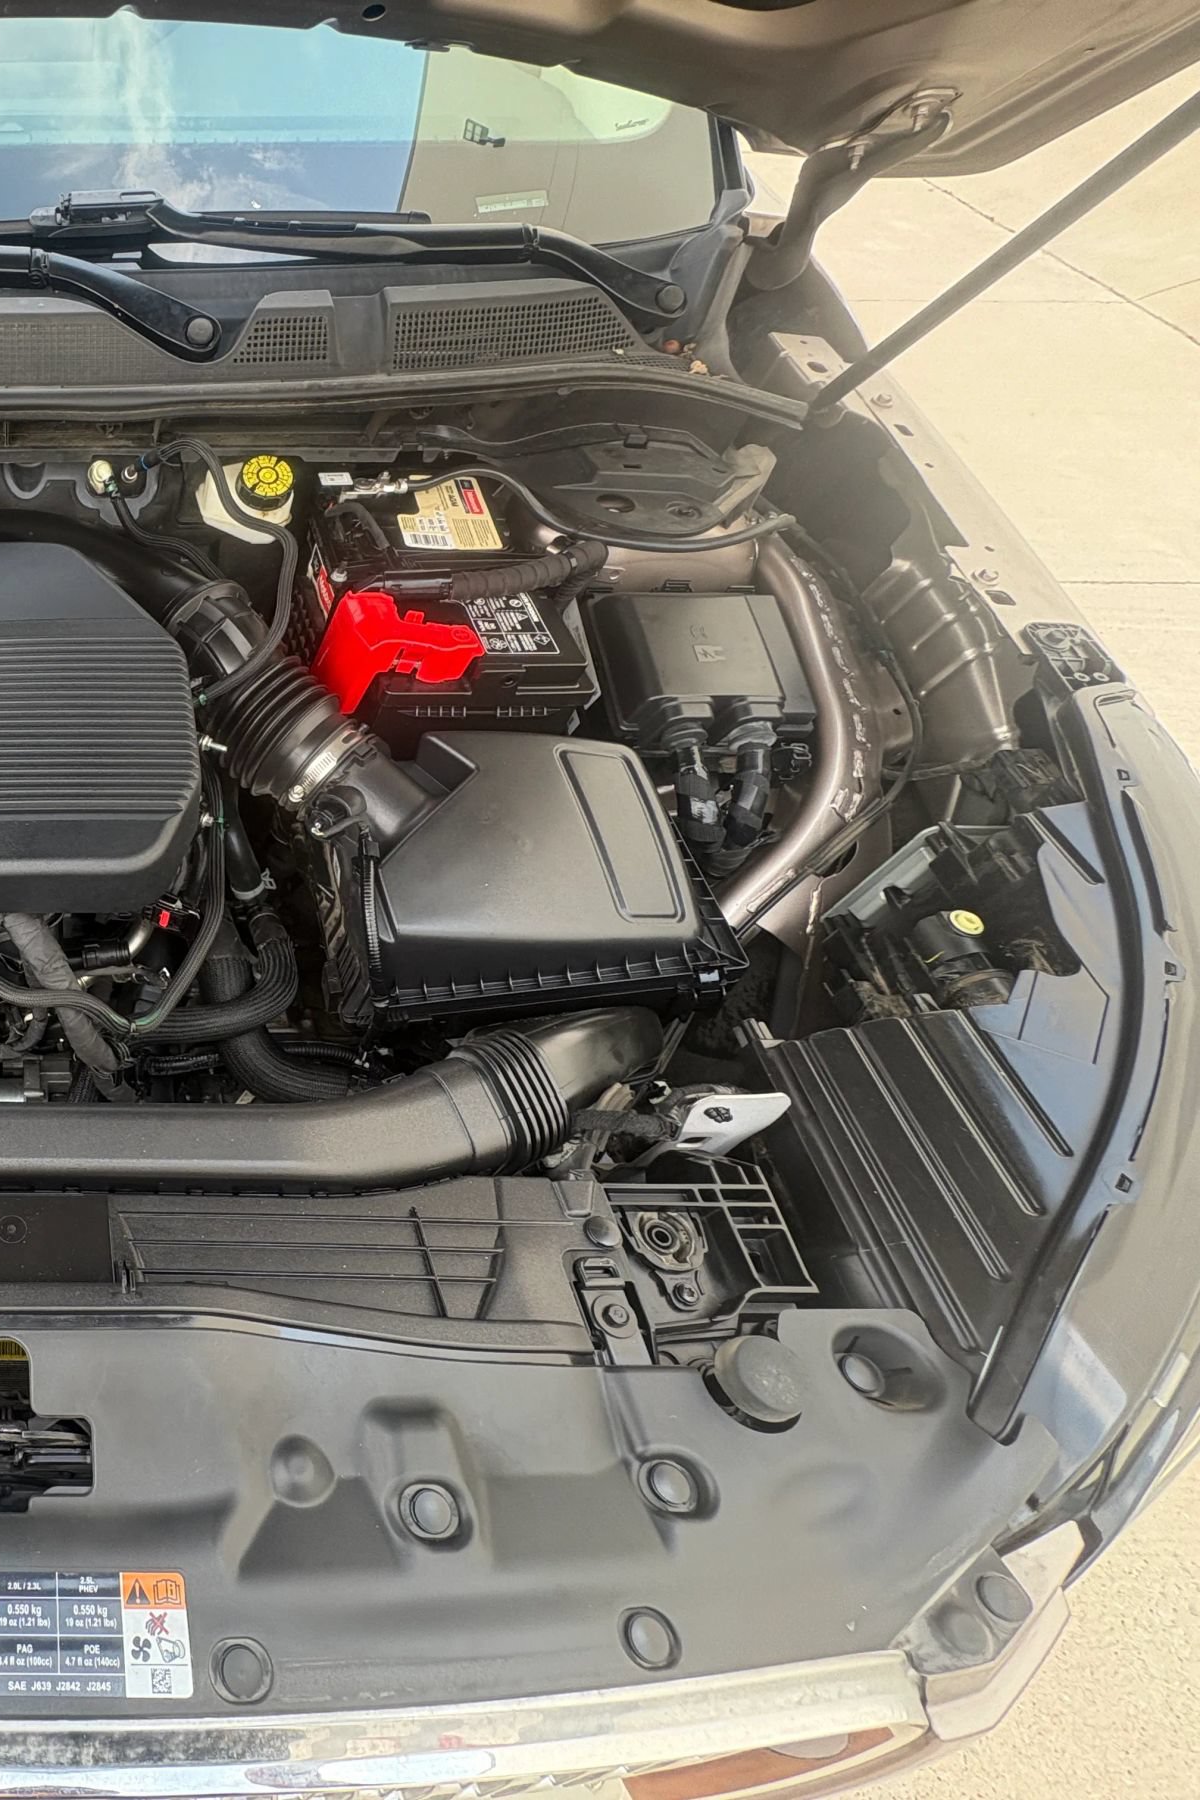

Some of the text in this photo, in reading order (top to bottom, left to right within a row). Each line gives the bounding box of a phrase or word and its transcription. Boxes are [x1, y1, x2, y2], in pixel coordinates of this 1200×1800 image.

[7, 1581, 21, 1590] 2.0L
[27, 1582, 41, 1590] 2.3L
[78, 1585, 99, 1593] PHEV
[7, 1604, 42, 1617] 0.550 kg
[73, 1604, 108, 1617] 0.550 kg
[0, 1618, 7, 1626] 19
[19, 1617, 35, 1628] (1.21
[37, 1617, 51, 1628] lbs)
[66, 1617, 117, 1629] 19 oz (1.21 lbs)
[16, 1644, 33, 1653] PAG
[84, 1644, 100, 1654] POE
[10, 1656, 14, 1665] fl
[16, 1658, 25, 1666] oz
[26, 1656, 53, 1668] (100cc)
[65, 1656, 120, 1668] 4.7 fl oz (140cc)
[7, 1681, 111, 1691] SAE J639 J2842 J2845
